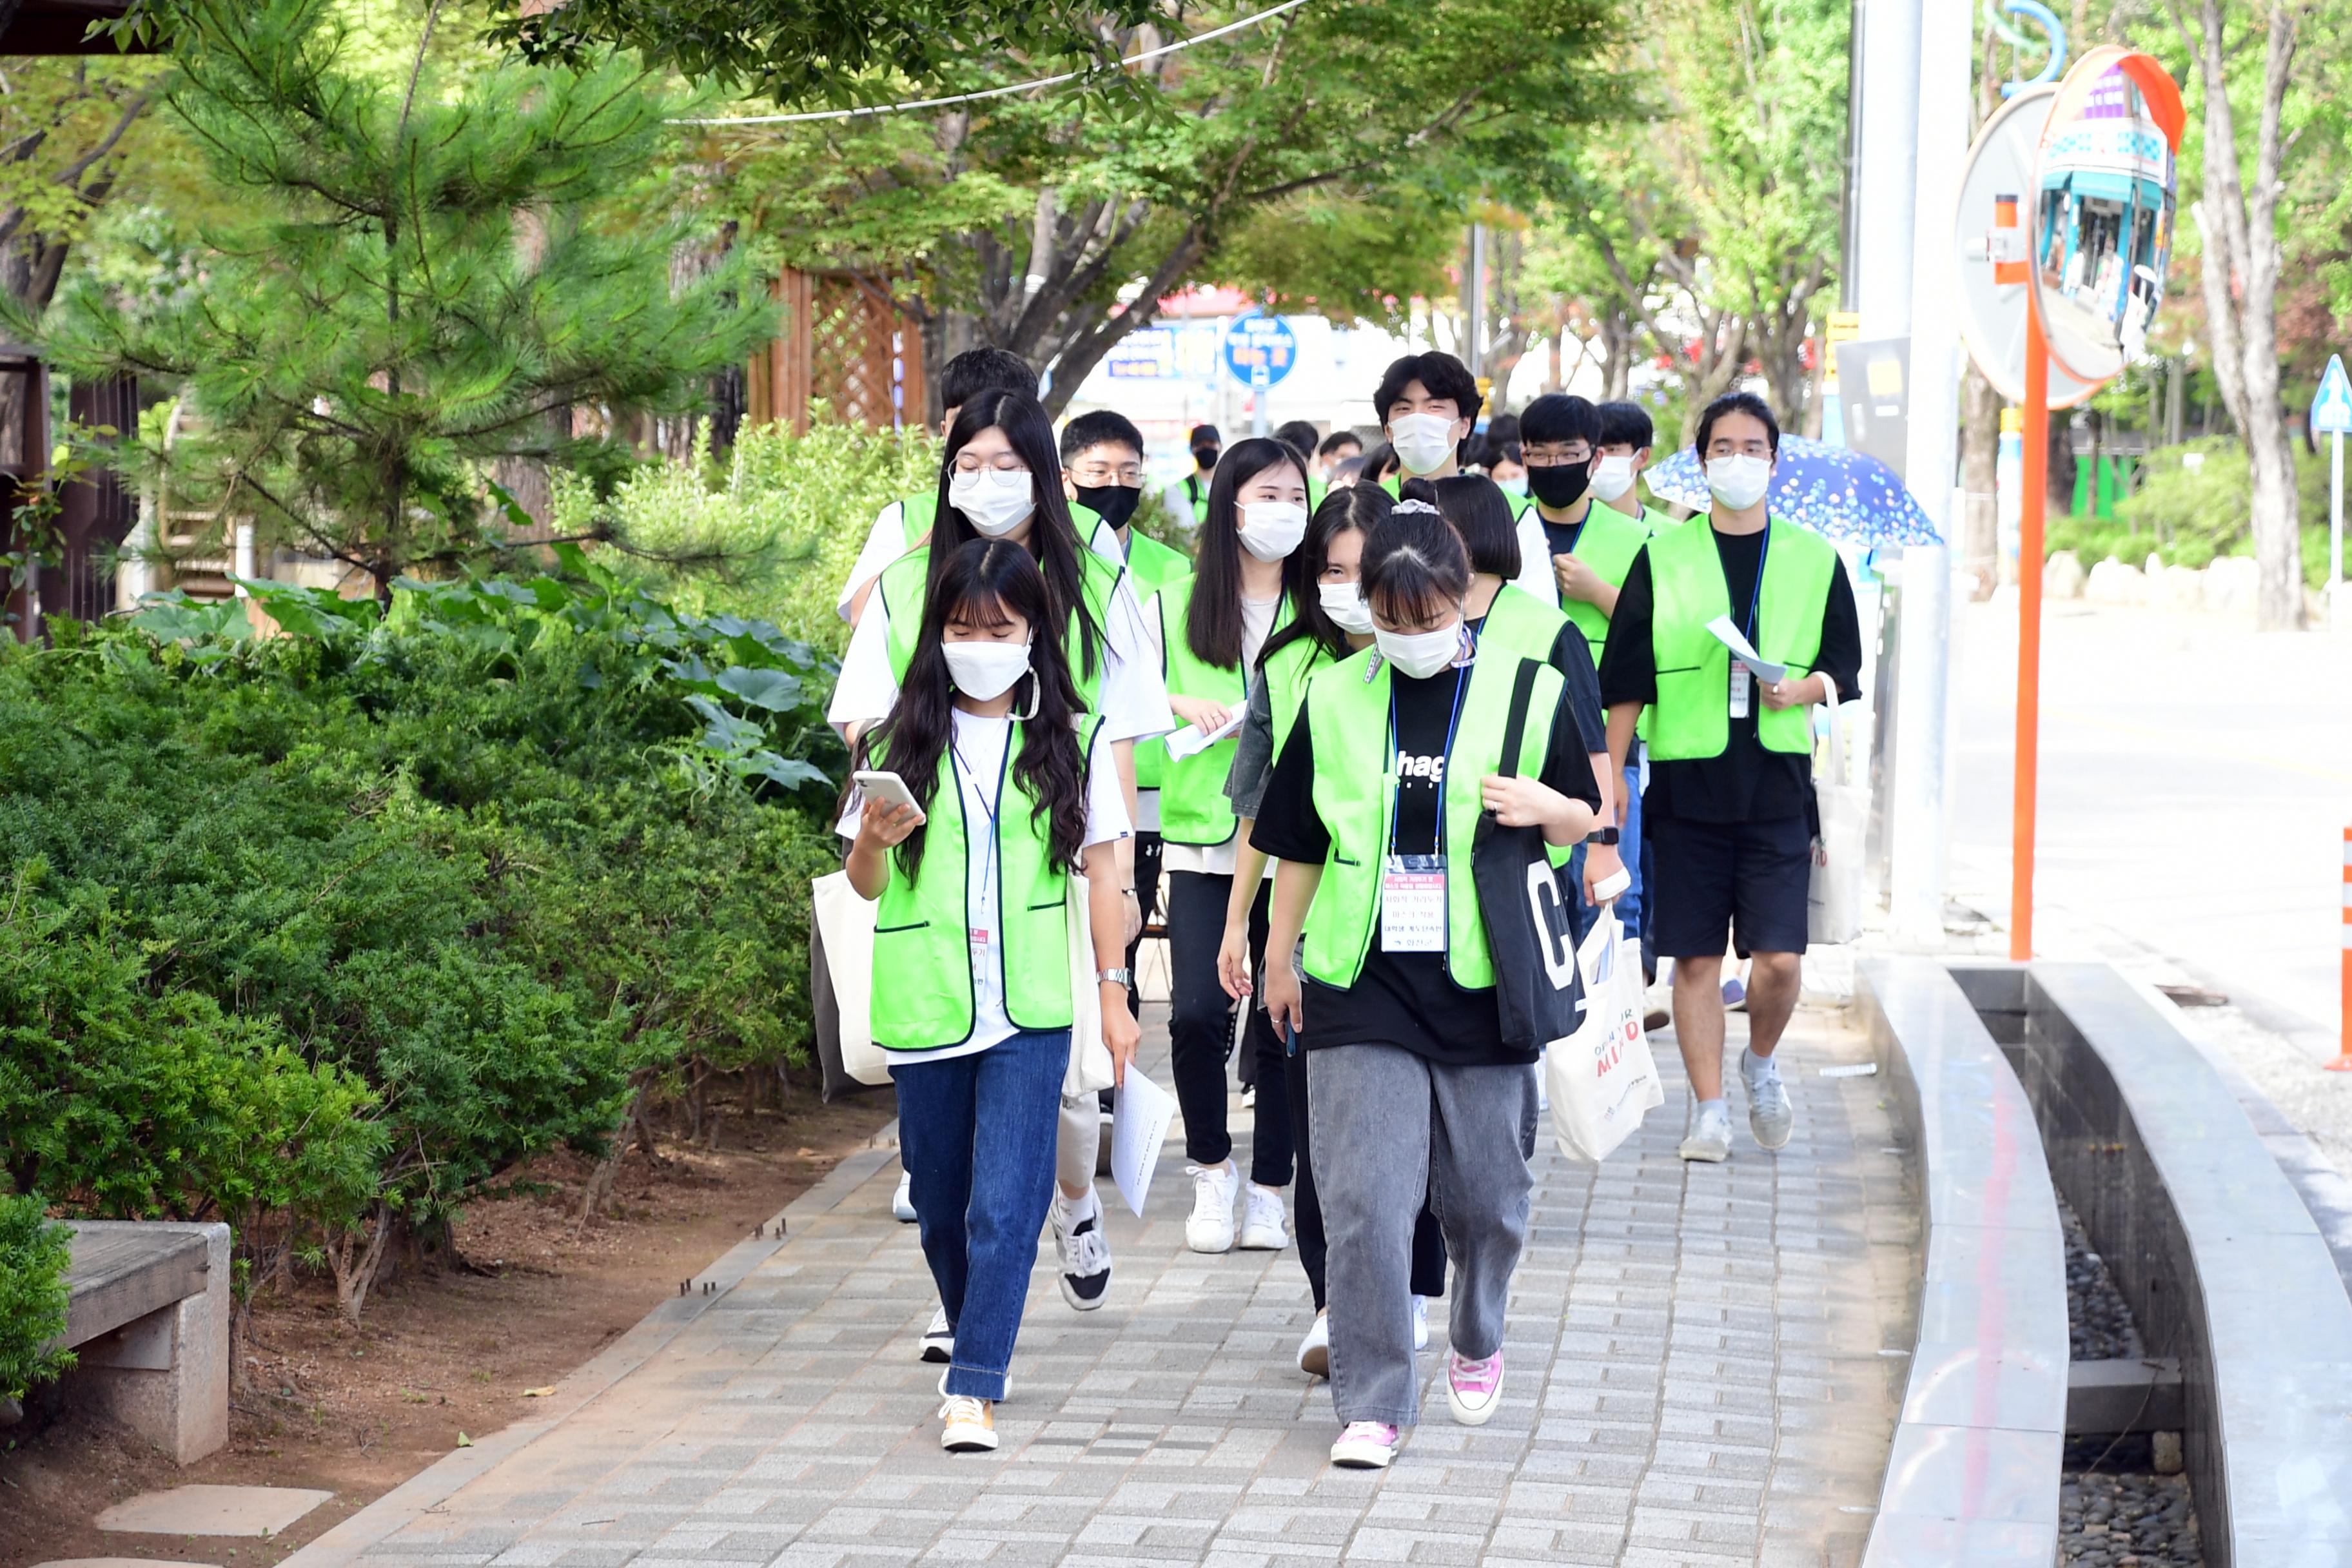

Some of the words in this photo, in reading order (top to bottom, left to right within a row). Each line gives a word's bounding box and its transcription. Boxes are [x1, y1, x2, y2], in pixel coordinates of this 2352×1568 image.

[1386, 895, 1407, 903] 사회적
[1413, 895, 1442, 903] 거리두기
[1393, 910, 1415, 919] 마스크
[1420, 910, 1434, 919] 착용
[1527, 859, 1574, 990] C
[1384, 925, 1405, 933] 대학생
